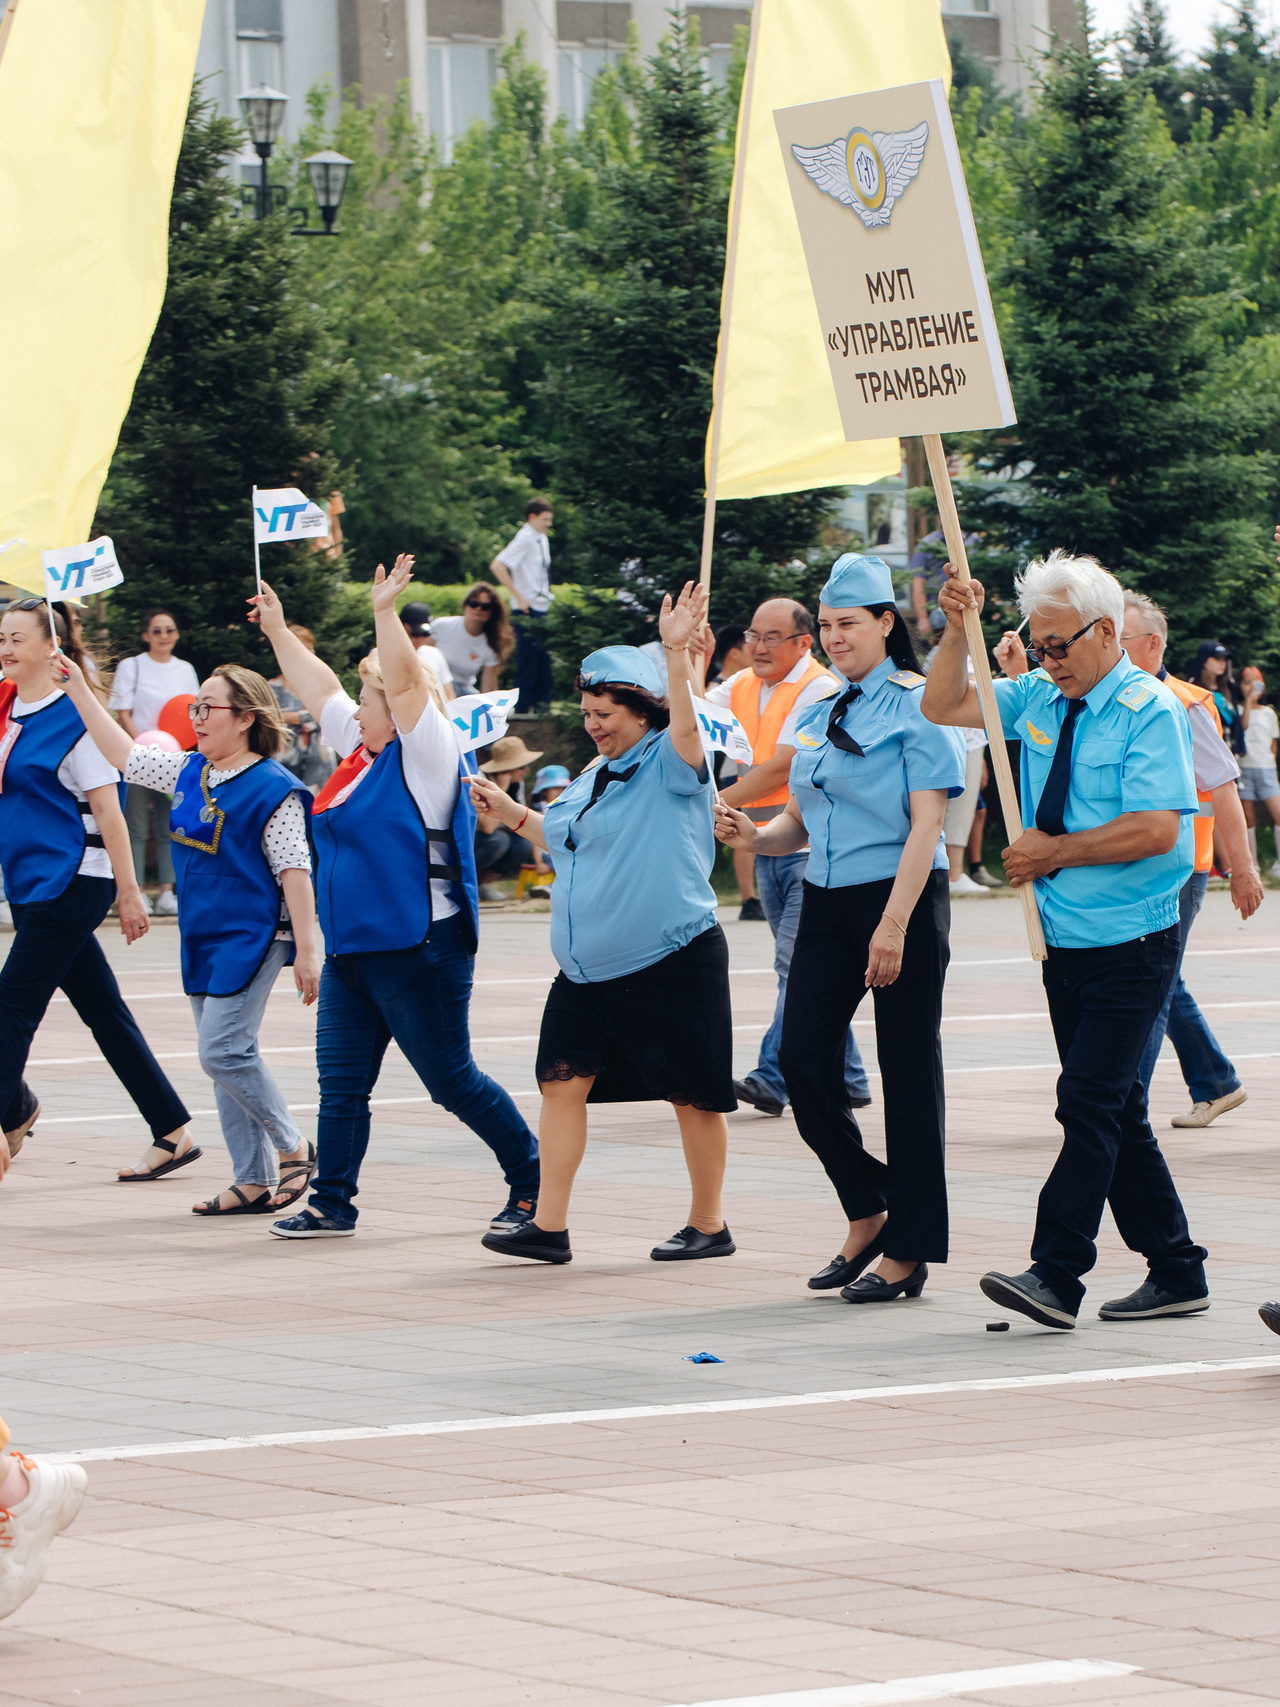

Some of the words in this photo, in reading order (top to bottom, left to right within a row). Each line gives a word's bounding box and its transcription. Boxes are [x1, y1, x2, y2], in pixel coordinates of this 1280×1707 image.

[865, 267, 915, 304] МУП
[827, 310, 979, 358] «УПРАВЛЕНИЕ
[855, 363, 967, 404] ТРАМВАЯ»
[255, 503, 309, 533] УТ
[46, 557, 95, 592] УТ
[452, 703, 495, 741] УТ
[698, 713, 734, 748] УТ
